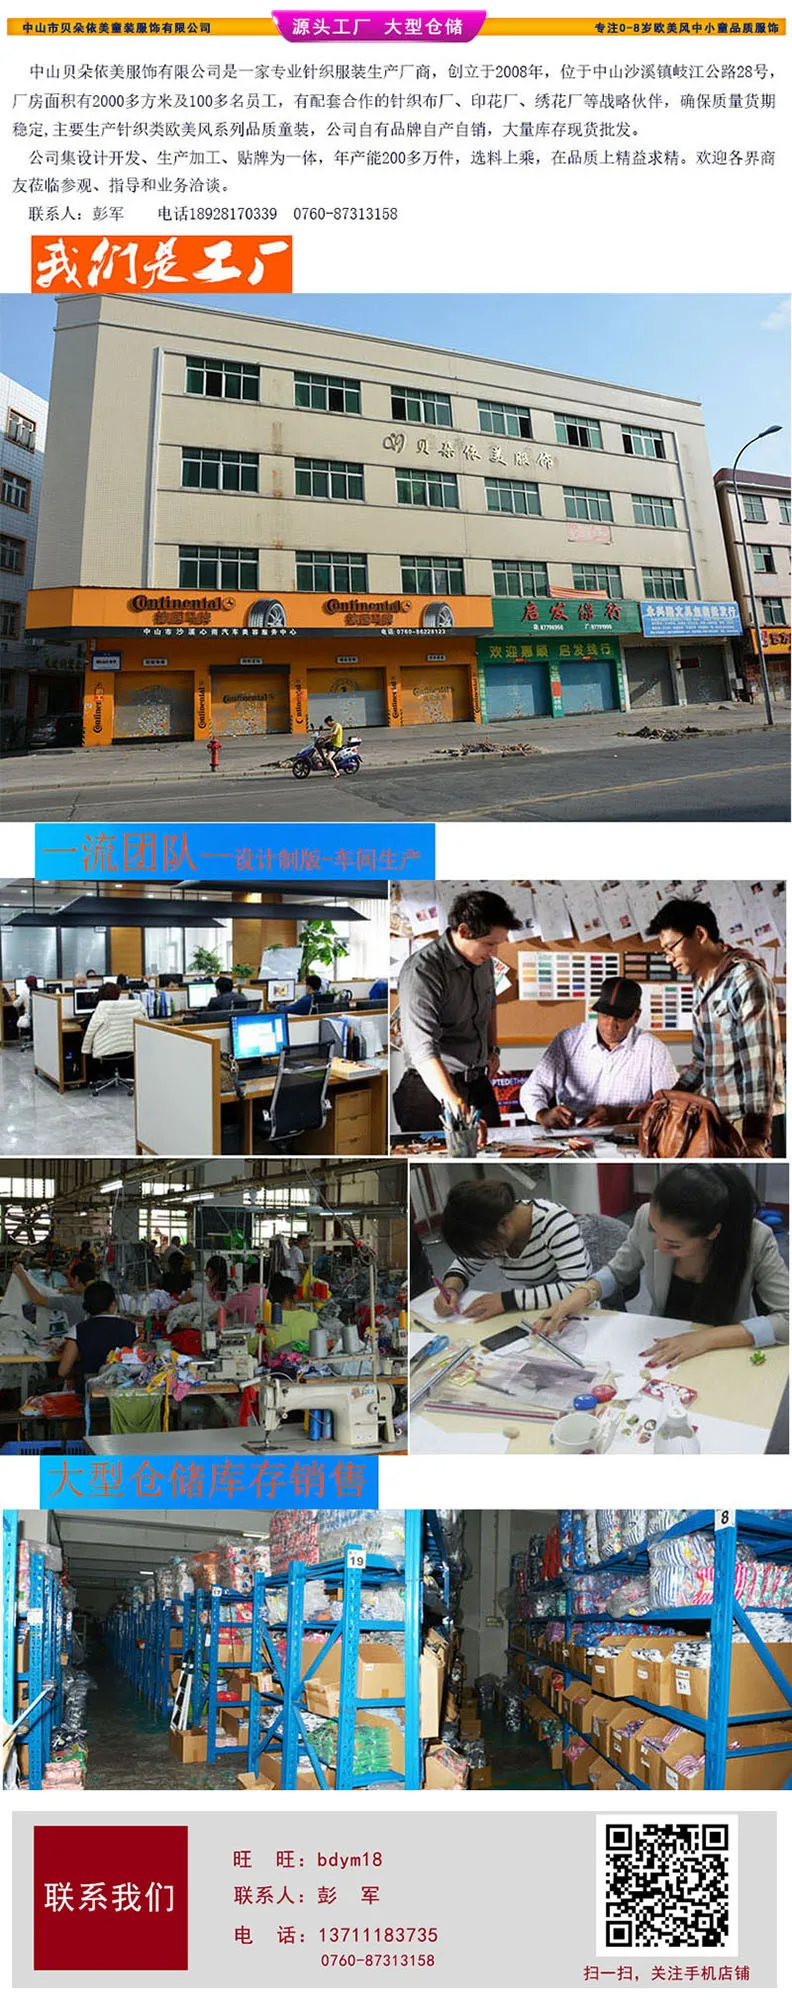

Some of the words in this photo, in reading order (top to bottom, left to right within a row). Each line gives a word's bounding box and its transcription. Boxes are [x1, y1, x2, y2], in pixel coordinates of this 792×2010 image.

[132, 594, 222, 611] Continental
[326, 598, 401, 615] Continental
[721, 1511, 729, 1525] 8
[349, 1556, 364, 1566] 19
